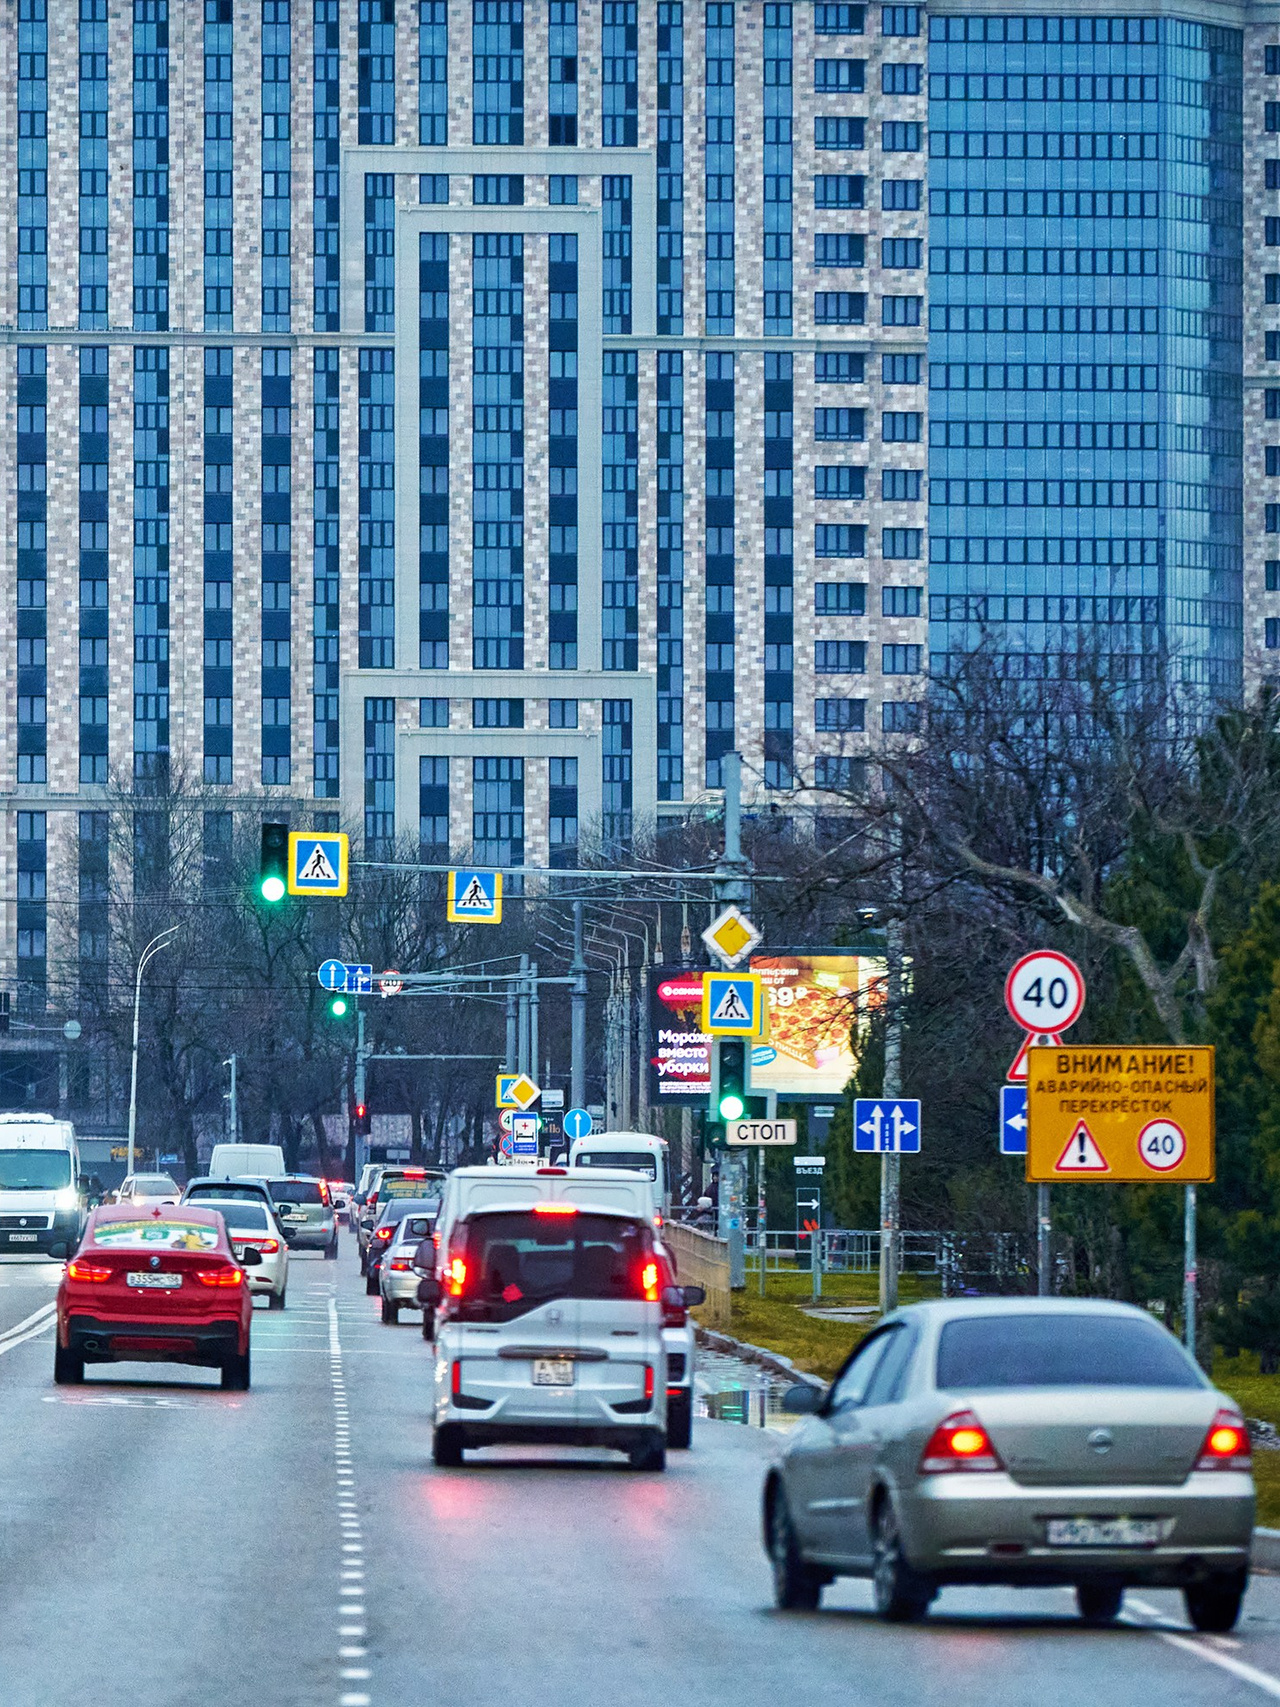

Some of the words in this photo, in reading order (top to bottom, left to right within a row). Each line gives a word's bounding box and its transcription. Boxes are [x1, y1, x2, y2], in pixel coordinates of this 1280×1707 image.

[1023, 977, 1069, 1009] 40
[658, 1030, 713, 1046] Мороже
[658, 1048, 708, 1058] вместо
[658, 1060, 709, 1076] уборки
[1057, 1054, 1195, 1075] ВНИМАНИЕ!
[1035, 1078, 1208, 1094] АВАРИЙНО-ОПАСНЫЙ
[1059, 1095, 1173, 1114] ПЕРЕКРЁСТОК
[737, 1124, 786, 1141] СТОП
[1147, 1135, 1175, 1156] 40
[796, 1167, 823, 1175] ВЪЕЗД
